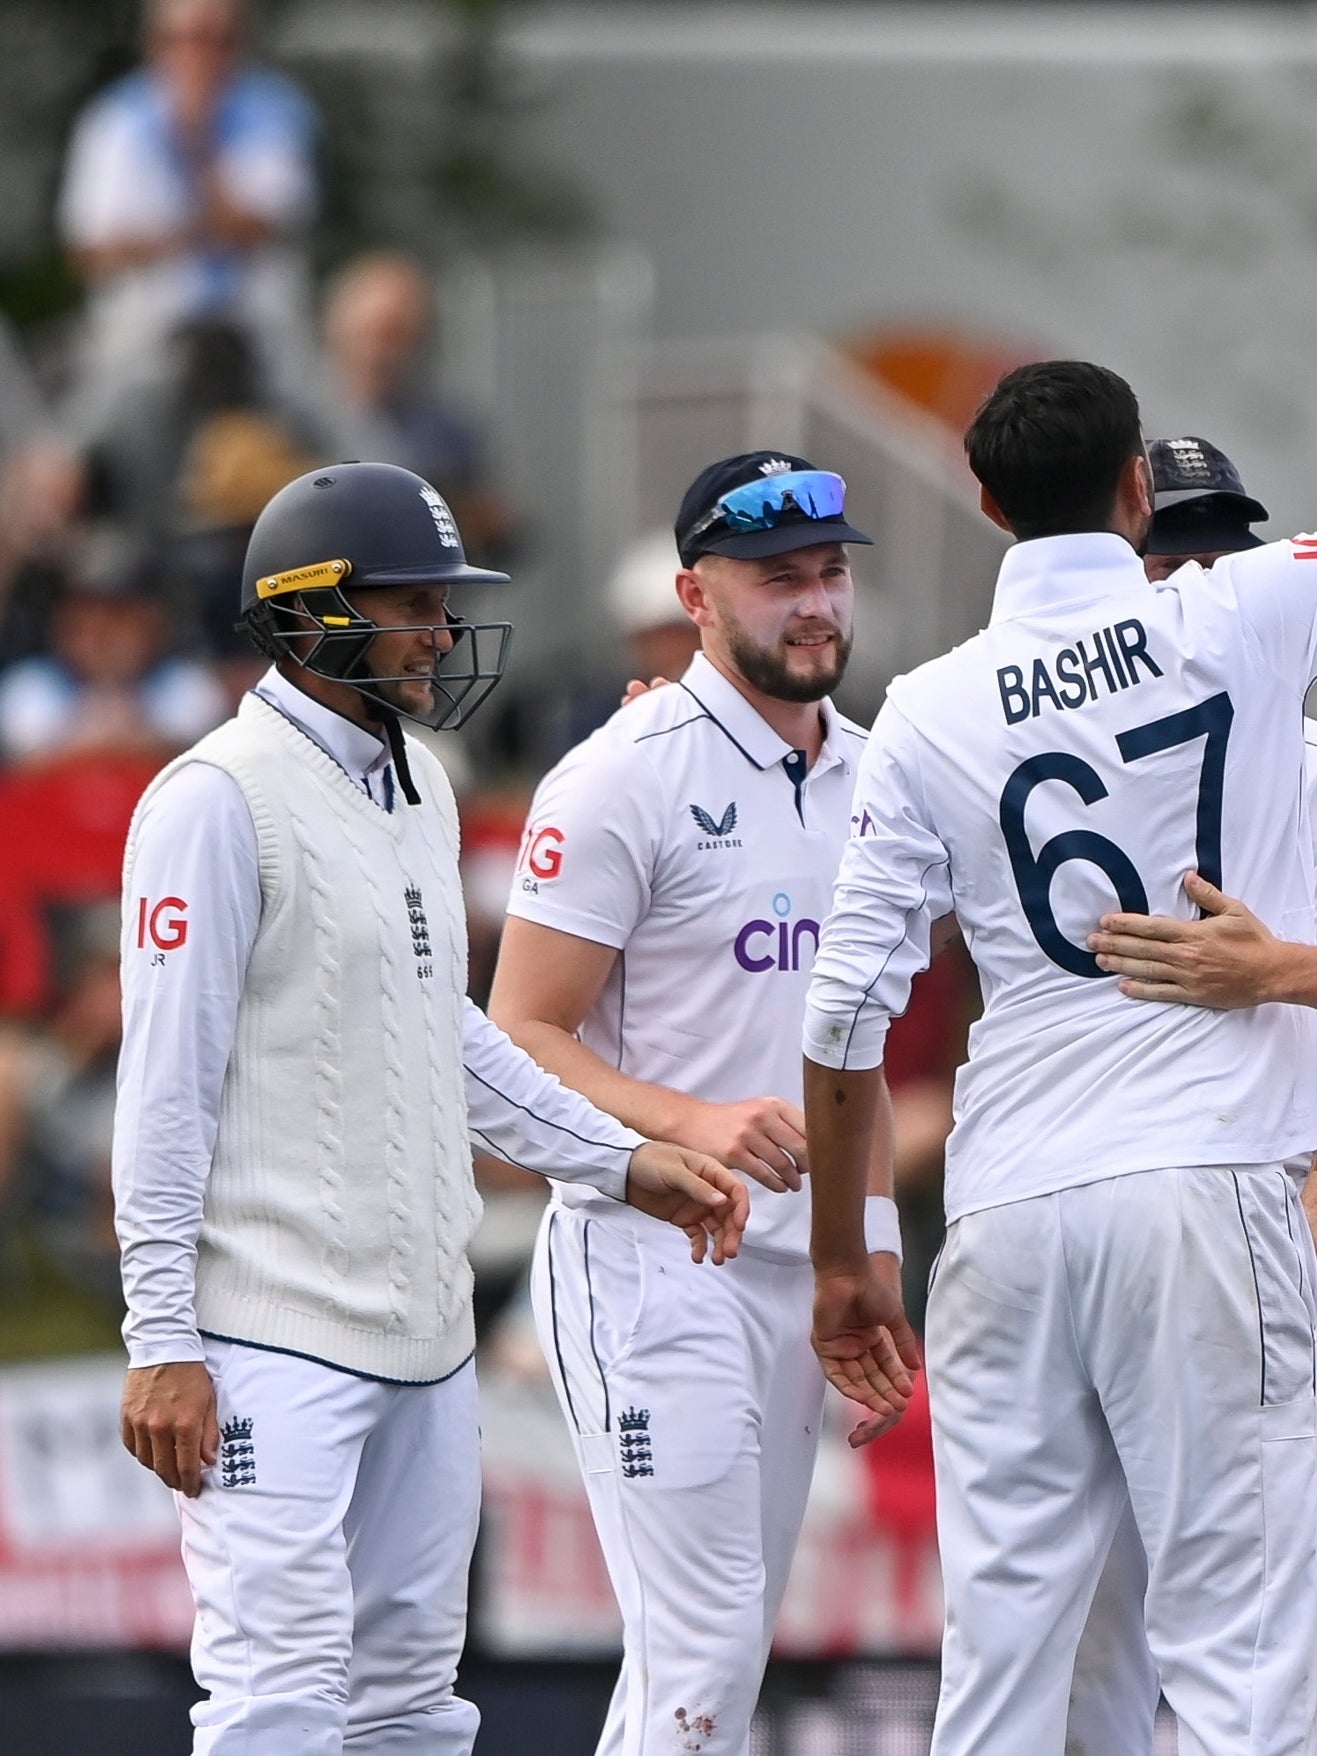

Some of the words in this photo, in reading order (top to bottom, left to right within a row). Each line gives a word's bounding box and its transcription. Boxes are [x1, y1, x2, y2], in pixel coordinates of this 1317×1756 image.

[281, 568, 328, 584] MASURI
[997, 618, 1164, 726] BASHIR
[517, 827, 566, 879] IG
[999, 690, 1235, 979] 67
[522, 878, 539, 895] GA
[137, 896, 188, 950] IG
[733, 892, 821, 973] cin
[150, 953, 166, 967] JR
